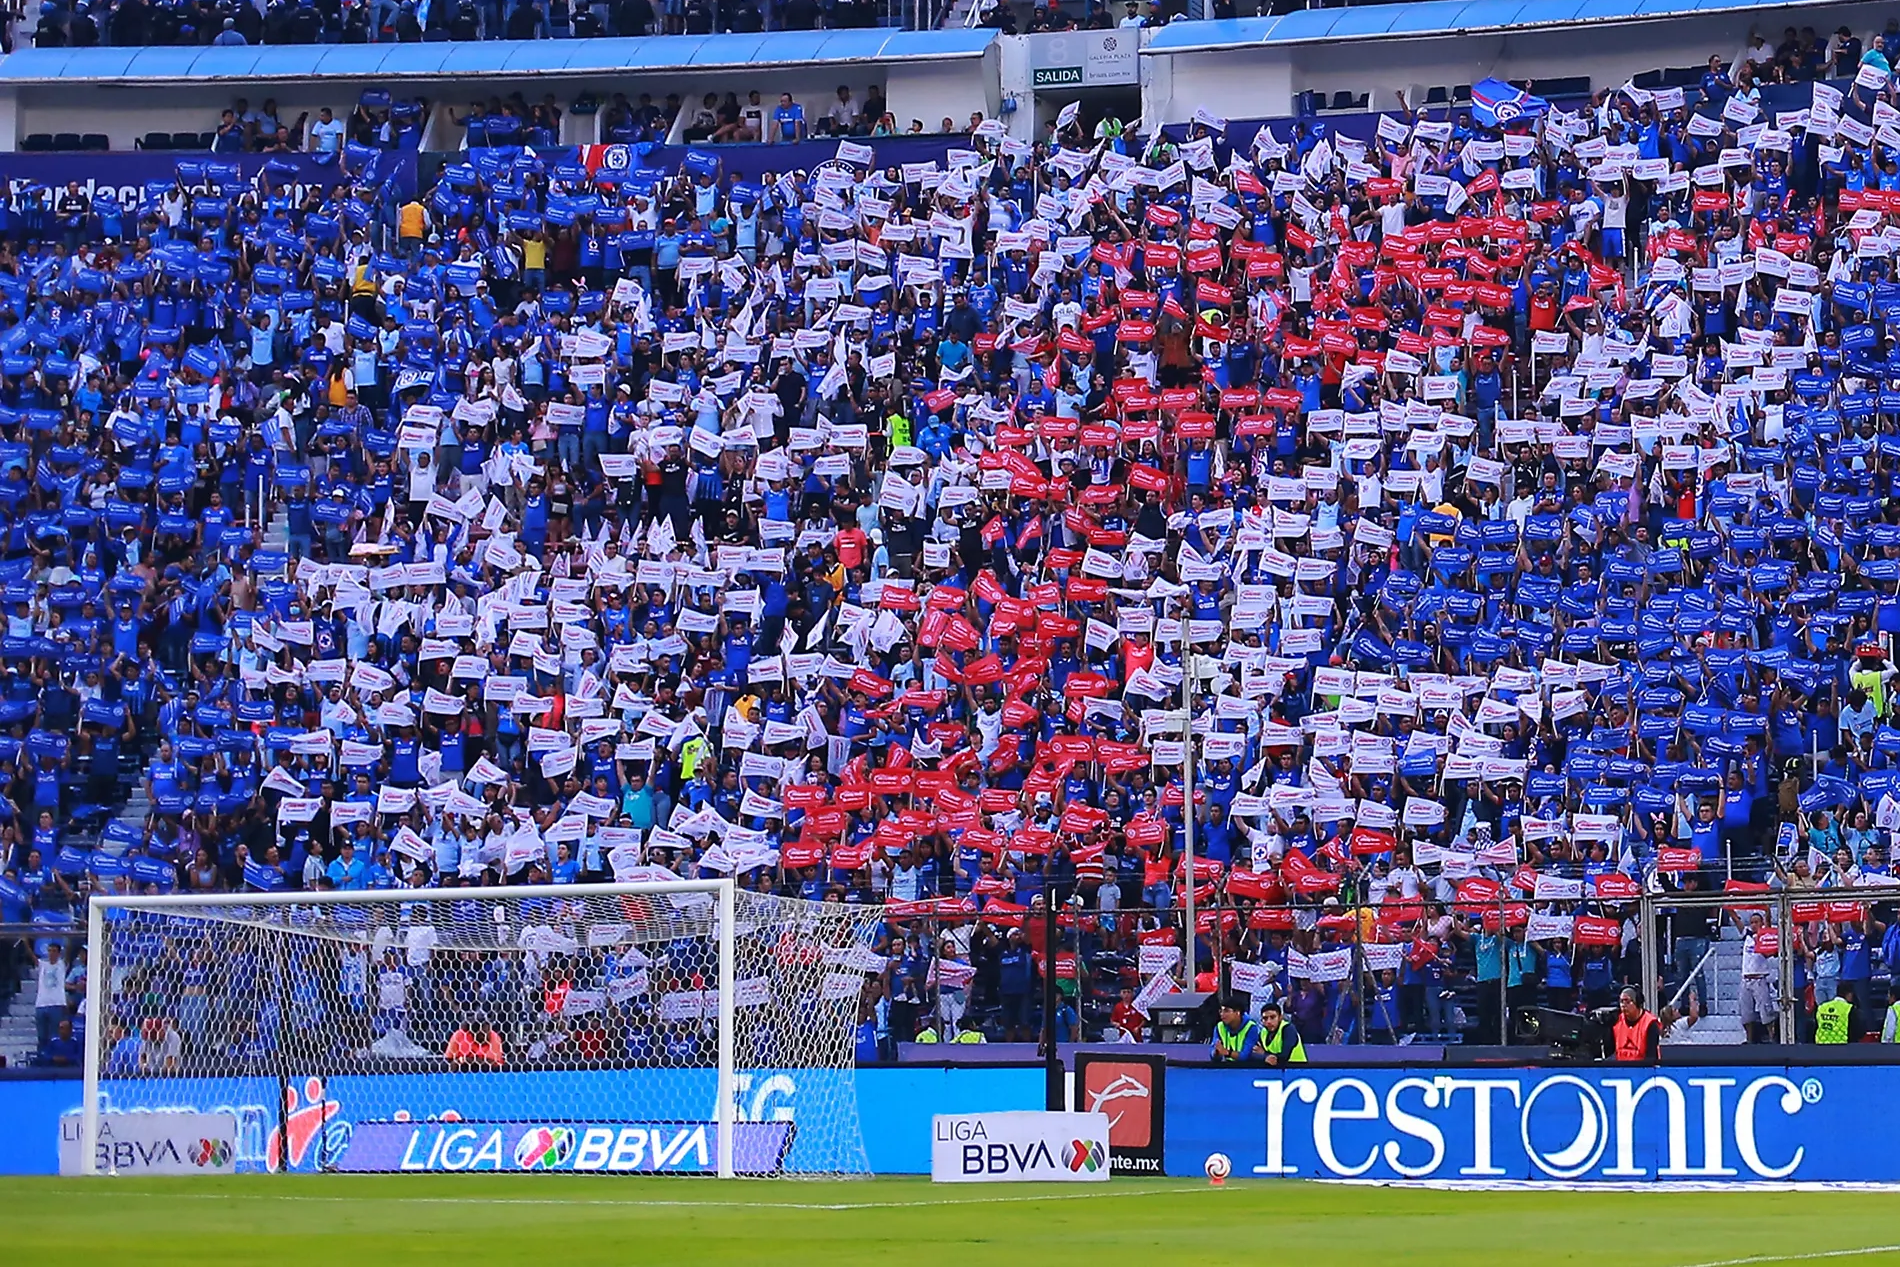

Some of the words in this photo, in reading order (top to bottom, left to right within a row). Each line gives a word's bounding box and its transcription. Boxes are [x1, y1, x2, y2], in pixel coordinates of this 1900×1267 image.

[1036, 70, 1081, 83] SALIDA
[62, 1121, 115, 1142] LIA
[937, 1120, 988, 1141] LIGA
[94, 1138, 182, 1170] BBVA
[400, 1128, 503, 1171] LIGA
[572, 1124, 709, 1170] BBVA
[962, 1139, 1056, 1175] BBVA
